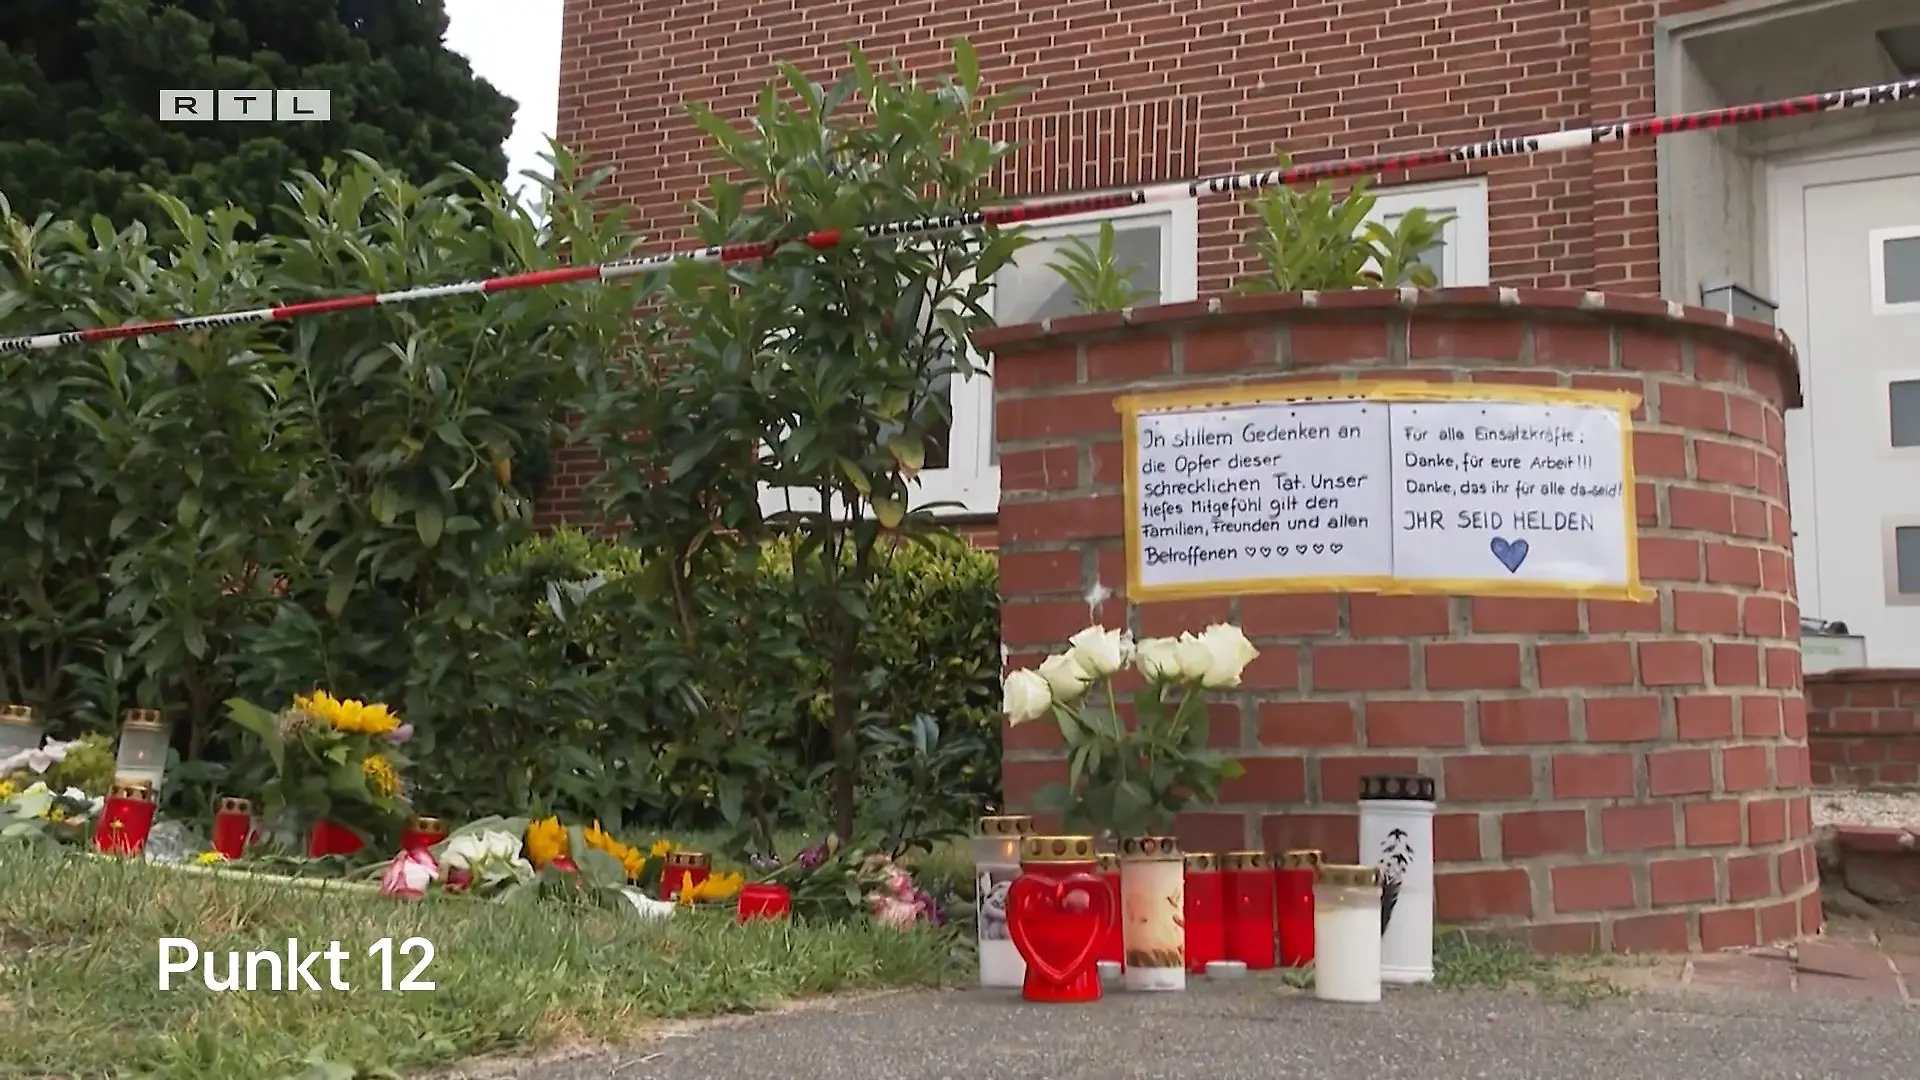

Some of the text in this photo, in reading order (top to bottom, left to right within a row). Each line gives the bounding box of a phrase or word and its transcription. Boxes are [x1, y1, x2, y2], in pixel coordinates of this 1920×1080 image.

[1172, 425, 1233, 448] stillem
[1242, 421, 1330, 443] Gedenken
[1338, 424, 1361, 438] an
[1439, 426, 1465, 441] alle
[1142, 452, 1283, 477] die Opfer dieser
[1405, 451, 1592, 472] Danke, für eure Arbeit!!!
[1144, 472, 1368, 498] schrecklichen Tat. Unser
[1406, 479, 1457, 497] Danke,
[1460, 480, 1487, 495] das
[1492, 479, 1509, 495] ihr
[1515, 480, 1535, 499] für
[1540, 479, 1565, 495] alle
[1142, 495, 1339, 521] tiefes Mitgefühl gilt den
[1141, 515, 1369, 538] Familien, Freunden und allen
[1457, 509, 1503, 530] SEID
[1513, 510, 1594, 531] HELDEN
[1145, 545, 1237, 567] Betroffenen
